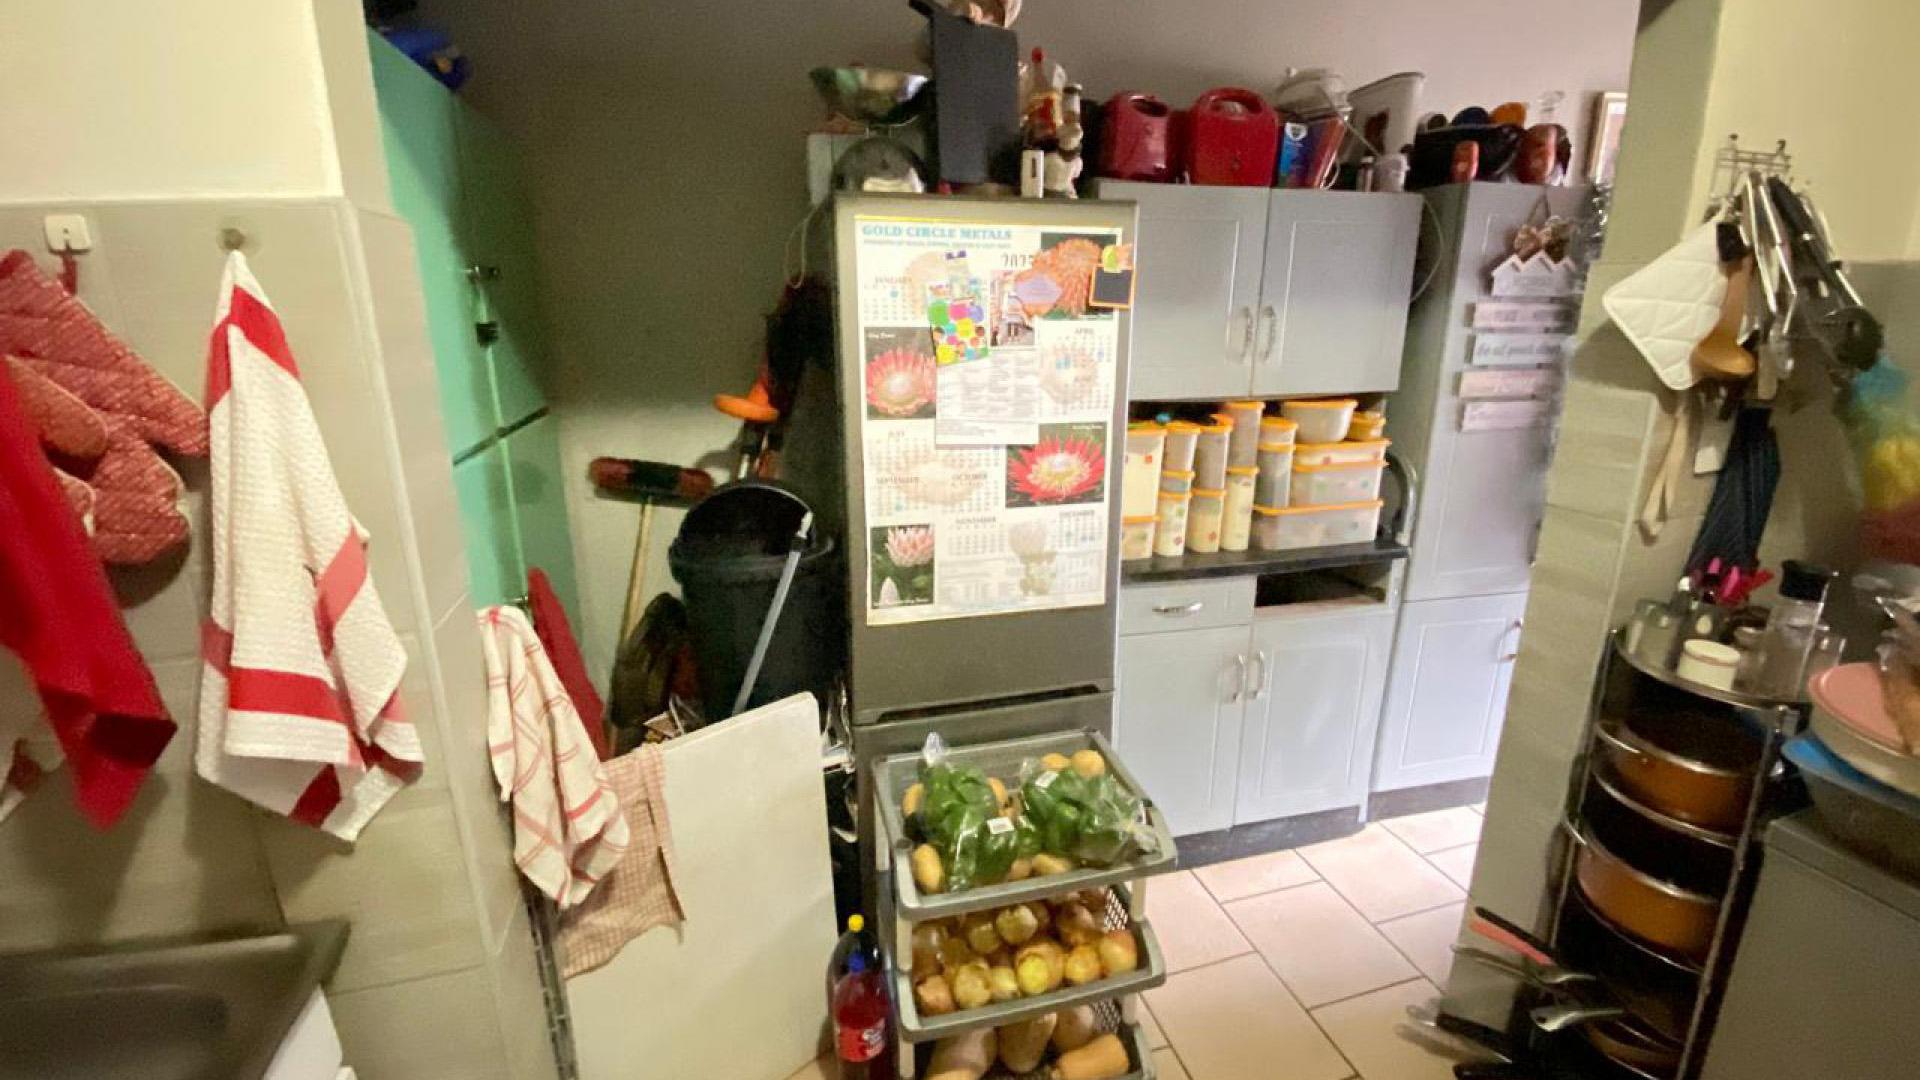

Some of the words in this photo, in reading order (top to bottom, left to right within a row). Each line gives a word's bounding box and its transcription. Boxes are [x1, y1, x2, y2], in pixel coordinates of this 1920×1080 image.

[863, 225, 902, 236] GOLD
[906, 226, 956, 238] CIRCLE
[960, 228, 1012, 240] METALS
